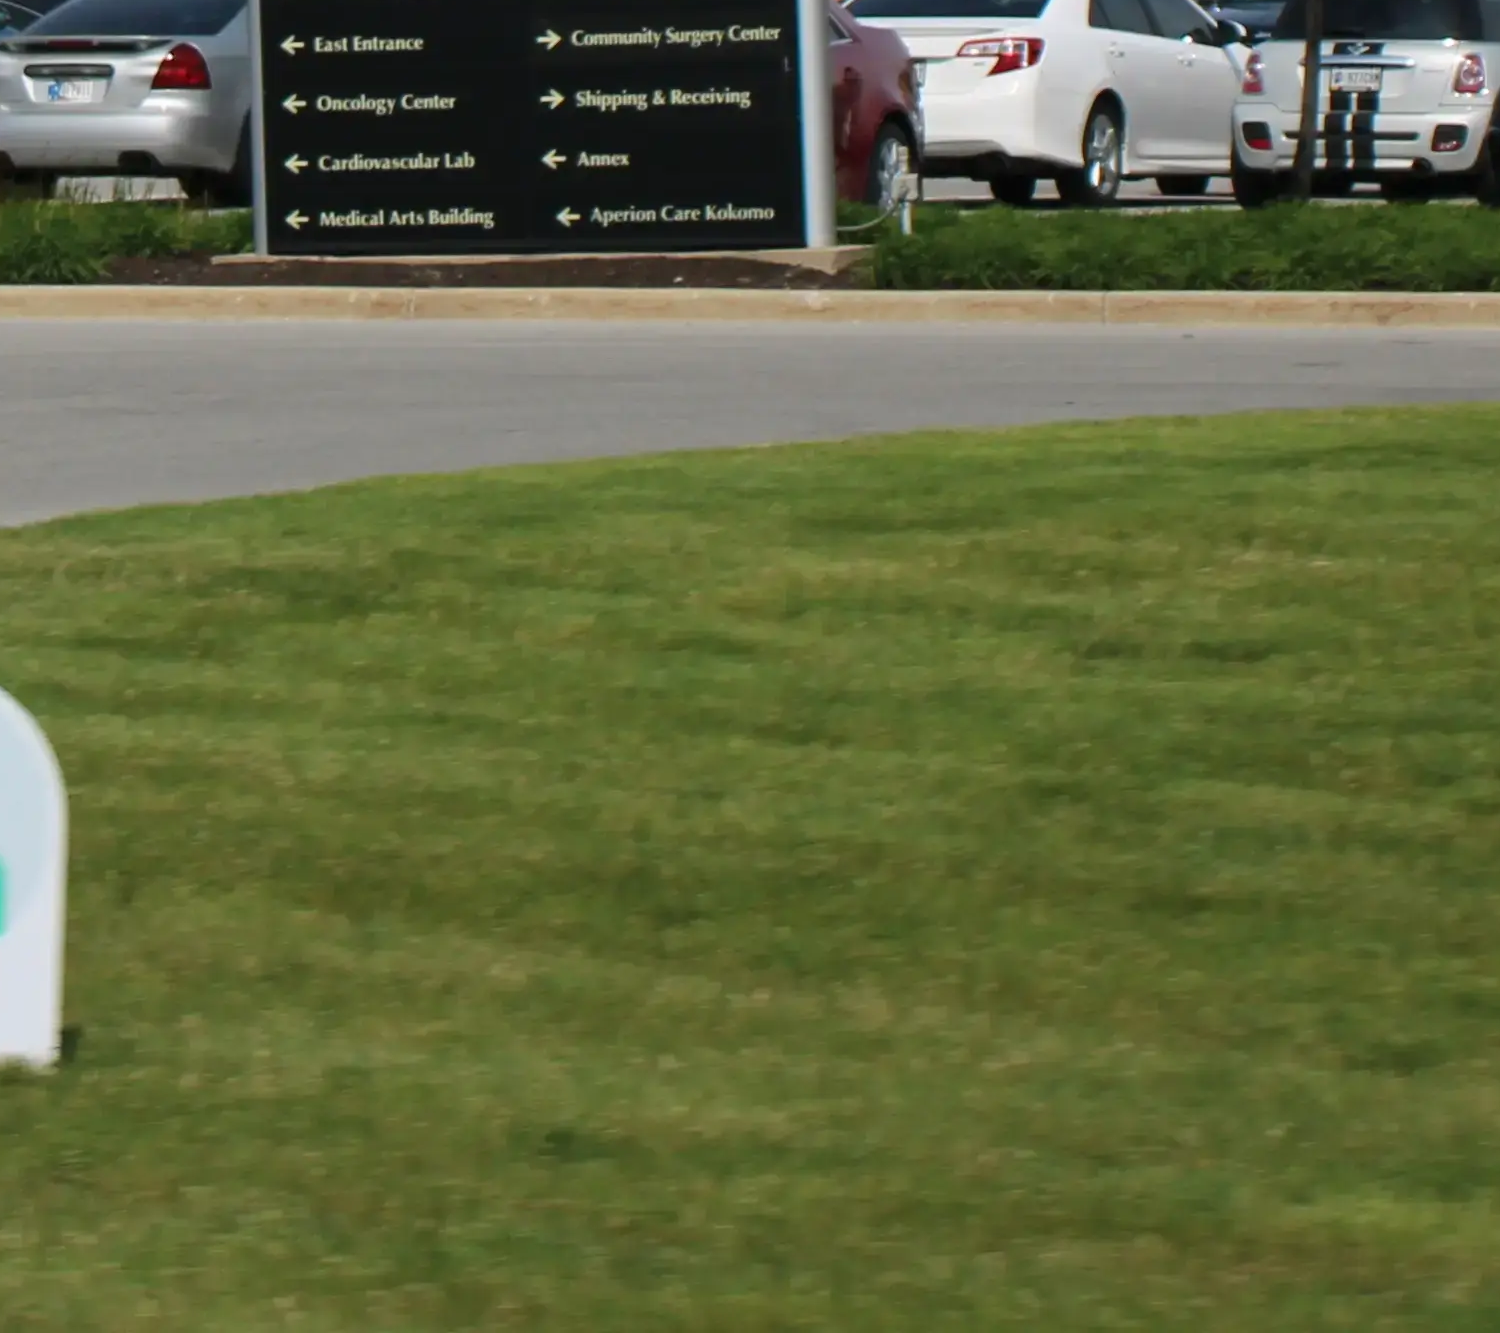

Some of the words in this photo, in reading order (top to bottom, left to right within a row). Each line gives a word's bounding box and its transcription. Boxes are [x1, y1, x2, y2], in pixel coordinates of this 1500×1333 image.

[314, 37, 348, 52] East
[353, 36, 424, 51] Entrance
[571, 28, 661, 48] Community
[665, 27, 725, 47] Surgery
[728, 25, 782, 41] Center
[316, 95, 396, 115] Oncology
[401, 95, 457, 110] Center
[576, 89, 648, 112] Shipping
[652, 90, 666, 105] &
[670, 88, 752, 108] Receiving
[318, 153, 440, 171] Cardiovascular
[444, 152, 476, 169] Lab
[577, 151, 630, 167] Annex
[319, 210, 384, 228] Medical
[389, 210, 424, 226] Arts
[428, 208, 495, 228] Building
[590, 205, 657, 227] Aperion
[661, 205, 701, 221] Care
[705, 203, 775, 221] Kokomo
